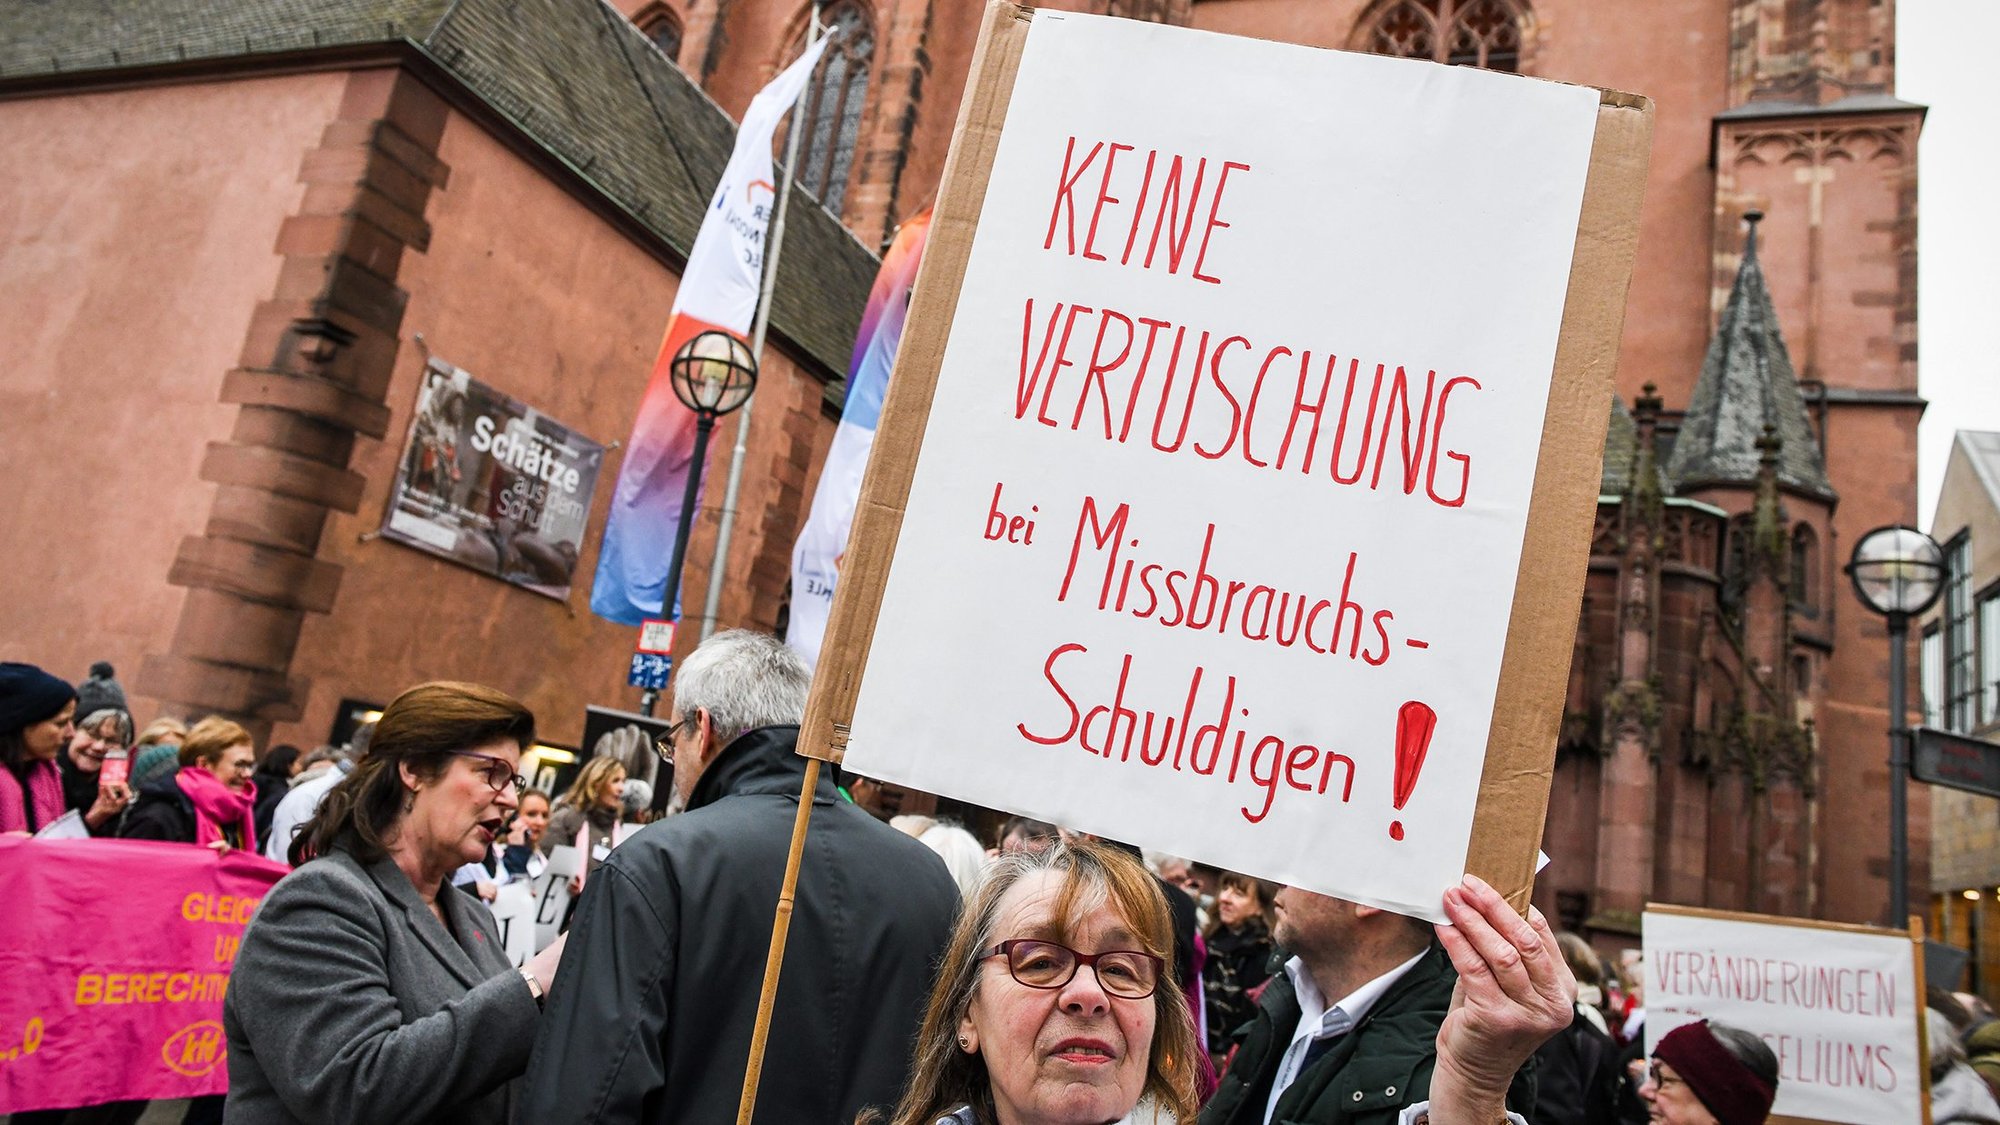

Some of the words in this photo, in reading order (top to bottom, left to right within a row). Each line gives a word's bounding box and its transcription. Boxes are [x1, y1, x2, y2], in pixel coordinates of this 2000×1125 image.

[1044, 136, 1250, 284] KEINE
[470, 414, 580, 494] Schätze
[1015, 298, 1482, 508] VERTUSCHUNG
[512, 475, 545, 504] aus
[984, 482, 1039, 547] bei
[1057, 496, 1429, 667] Missbrauchs-
[1017, 643, 1356, 824] Schuldigen
[536, 874, 569, 925] E
[1655, 949, 1897, 1018] VERÄNDERUNGEN
